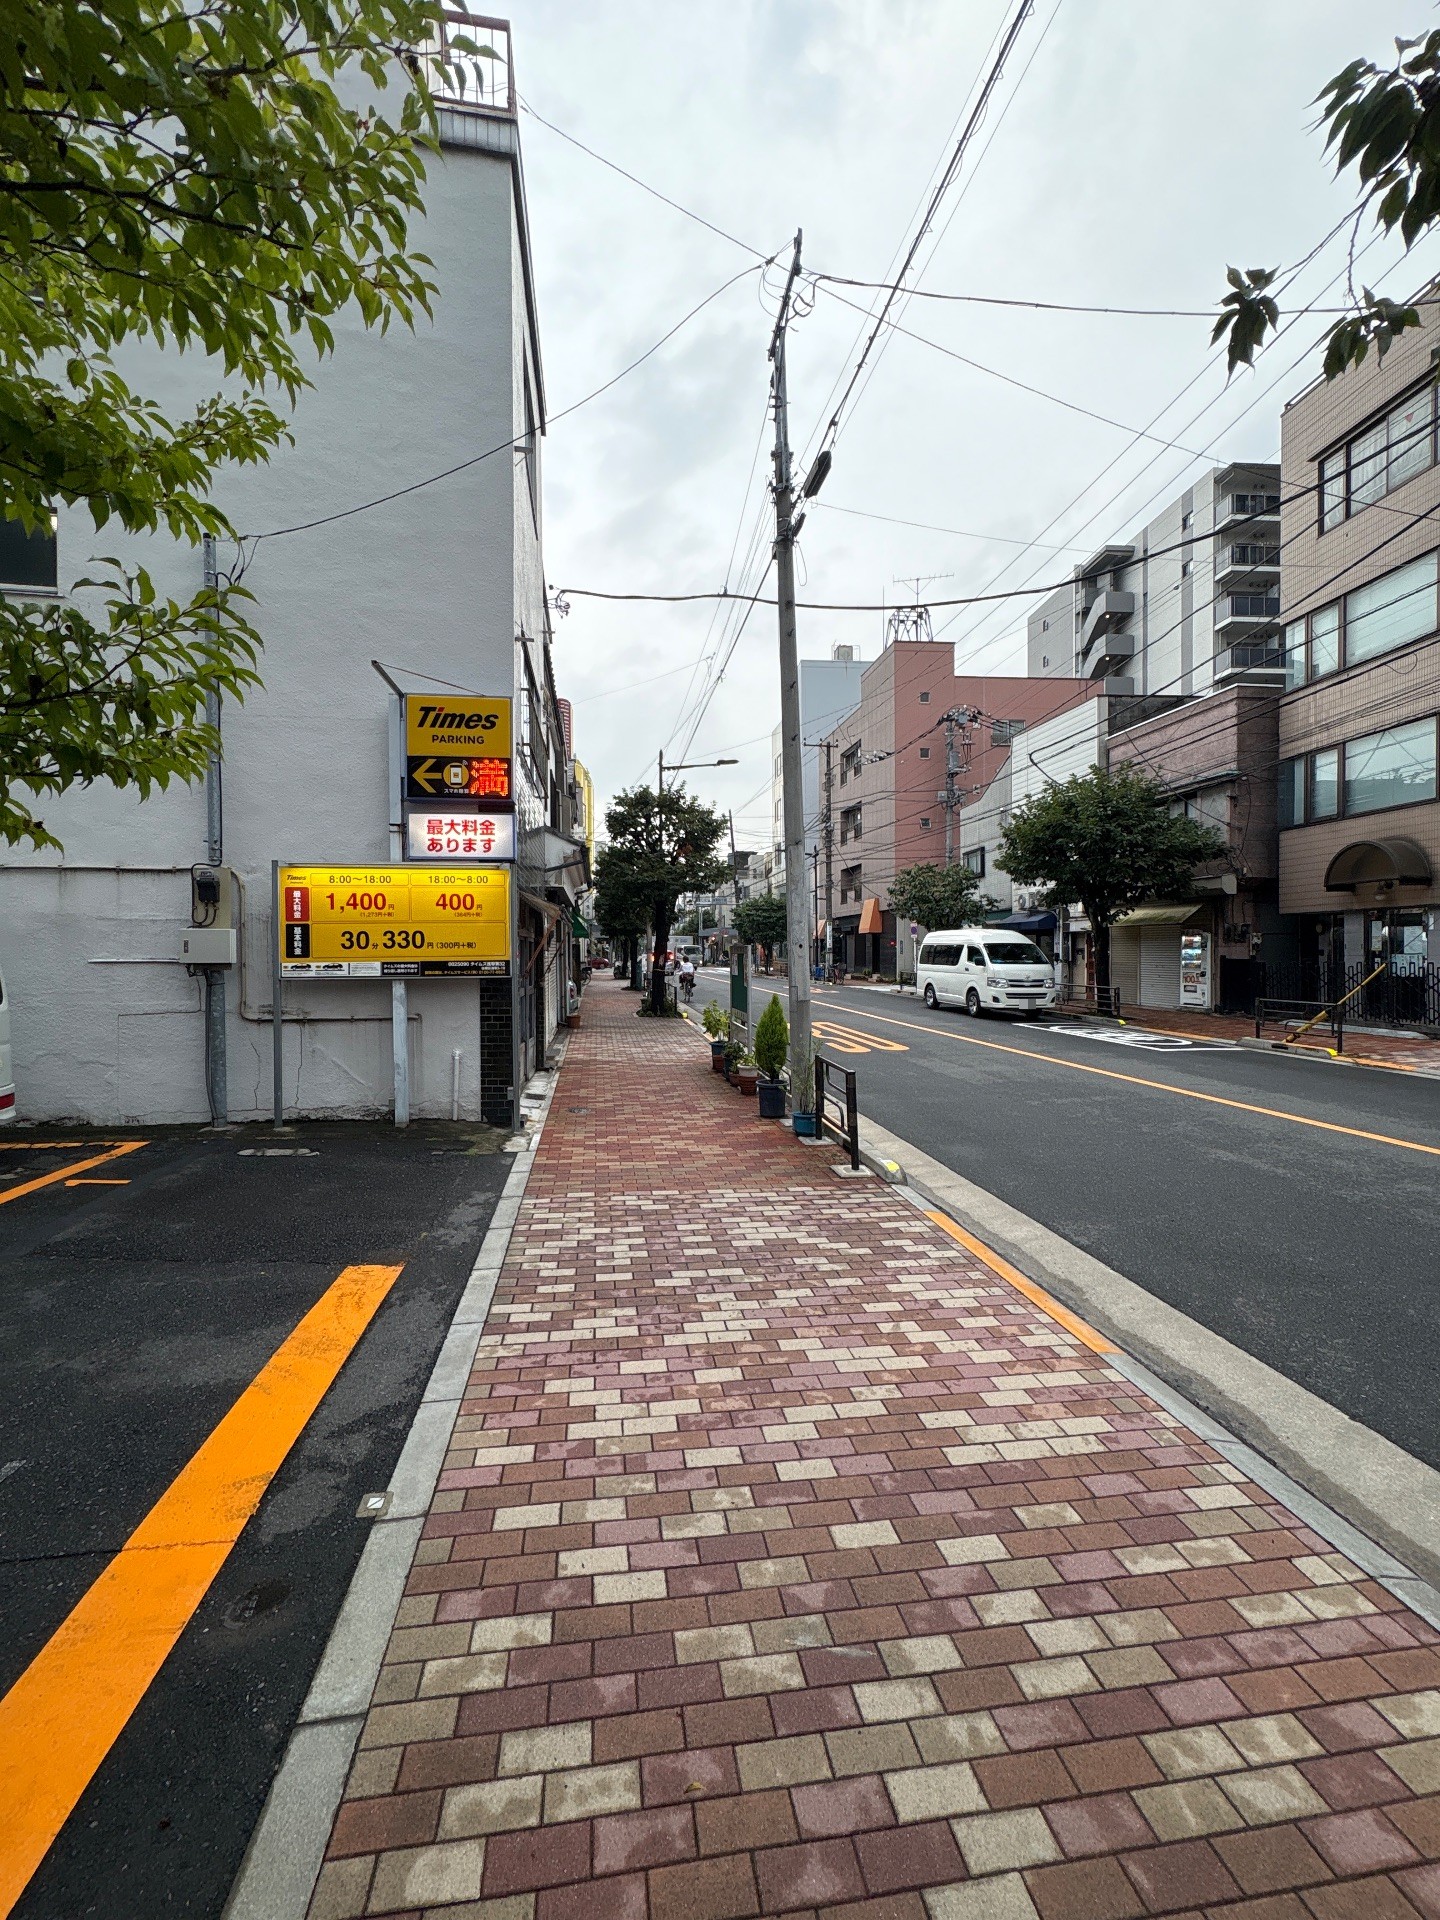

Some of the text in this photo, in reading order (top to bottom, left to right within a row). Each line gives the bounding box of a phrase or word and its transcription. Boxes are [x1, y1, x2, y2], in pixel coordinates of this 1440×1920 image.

[417, 706, 499, 730] Times
[432, 734, 485, 745] PARKING
[470, 758, 509, 797] 満
[426, 819, 496, 836] 最大料金
[426, 837, 496, 853] あります
[292, 890, 302, 919] 最大料金
[293, 926, 302, 955] 基本料金
